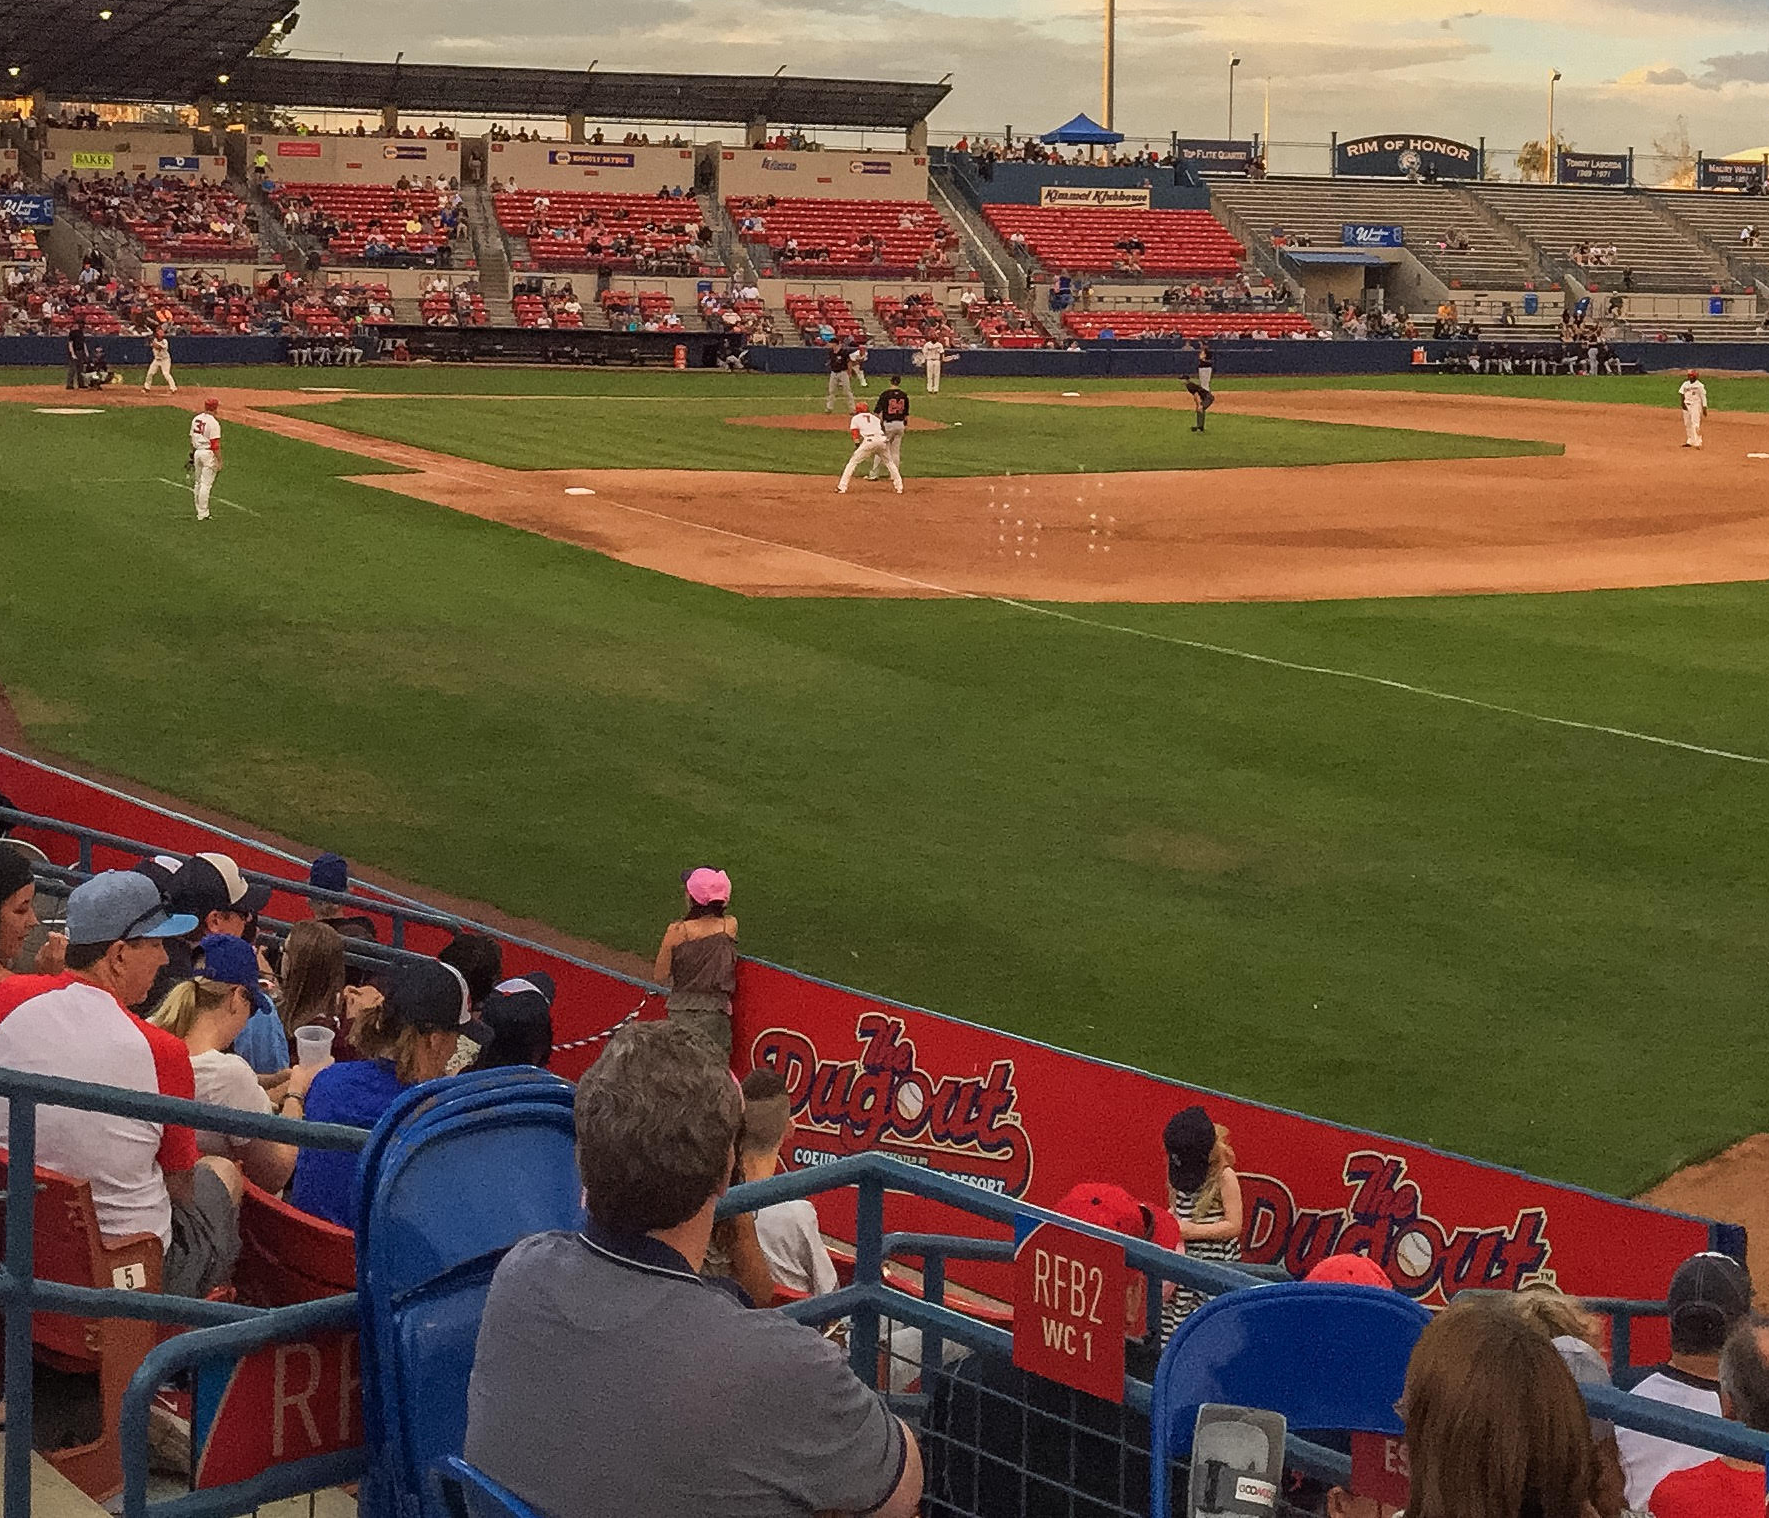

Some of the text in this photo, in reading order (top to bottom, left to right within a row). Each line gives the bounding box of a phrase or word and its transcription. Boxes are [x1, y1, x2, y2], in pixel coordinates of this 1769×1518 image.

[75, 155, 111, 165] BAKER
[1347, 139, 1471, 161] RIM OF HONOR
[858, 1013, 917, 1074] The
[752, 1028, 1018, 1152] Dugout
[1345, 1151, 1422, 1220] The
[123, 1268, 135, 1289] 5
[1033, 1248, 1103, 1324] RFB2
[1042, 1317, 1092, 1361] WC 1
